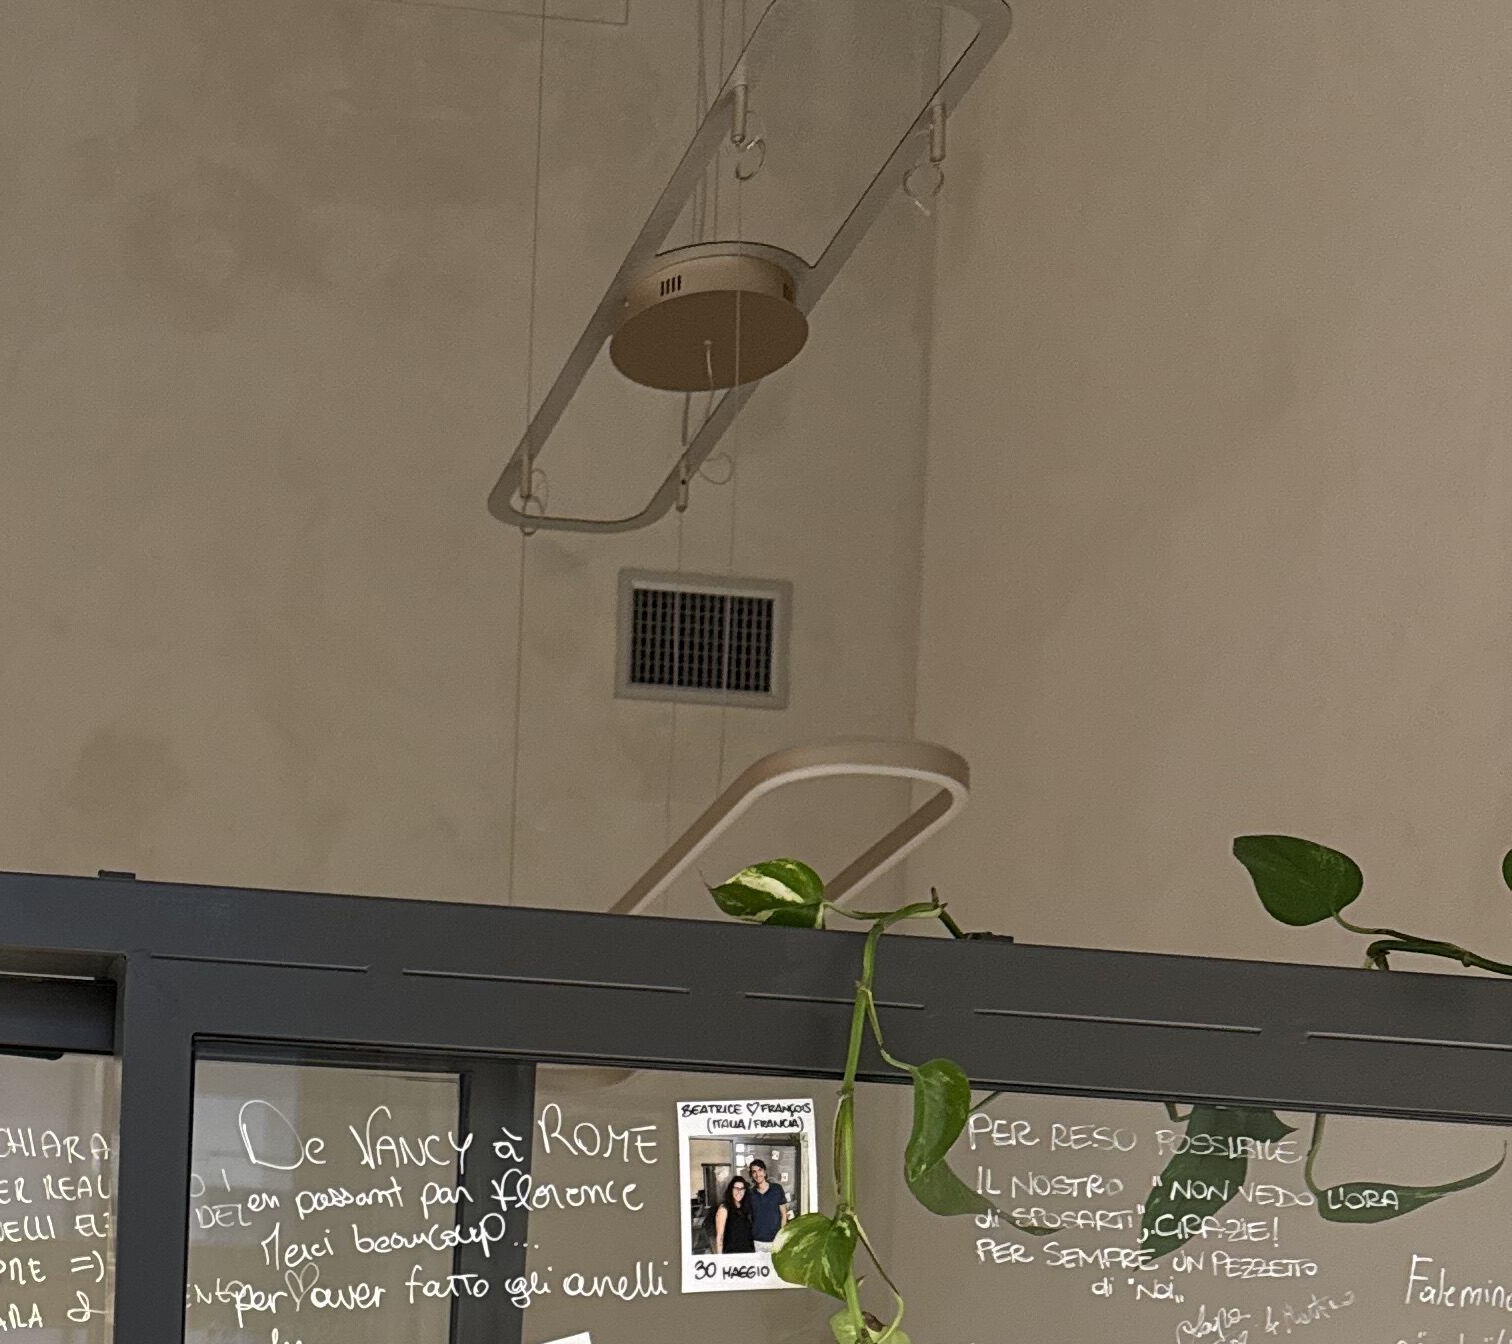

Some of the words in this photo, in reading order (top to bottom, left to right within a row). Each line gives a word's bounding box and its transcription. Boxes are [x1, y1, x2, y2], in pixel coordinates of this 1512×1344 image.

[494, 1128, 524, 1163] à
[539, 1103, 658, 1164] ROME
[968, 1113, 1039, 1150] PER
[43, 1174, 112, 1202] REAL
[976, 1165, 1000, 1194] IL
[1011, 1172, 1123, 1198] NOSTRO
[1239, 1182, 1316, 1207] VEDO
[262, 1222, 334, 1272] Merci
[976, 1239, 1034, 1264] PER
[1043, 1242, 1158, 1271] SEMPRE
[1173, 1251, 1204, 1273] UN
[694, 1260, 716, 1280] 30
[1405, 1254, 1512, 1312] Falemin
